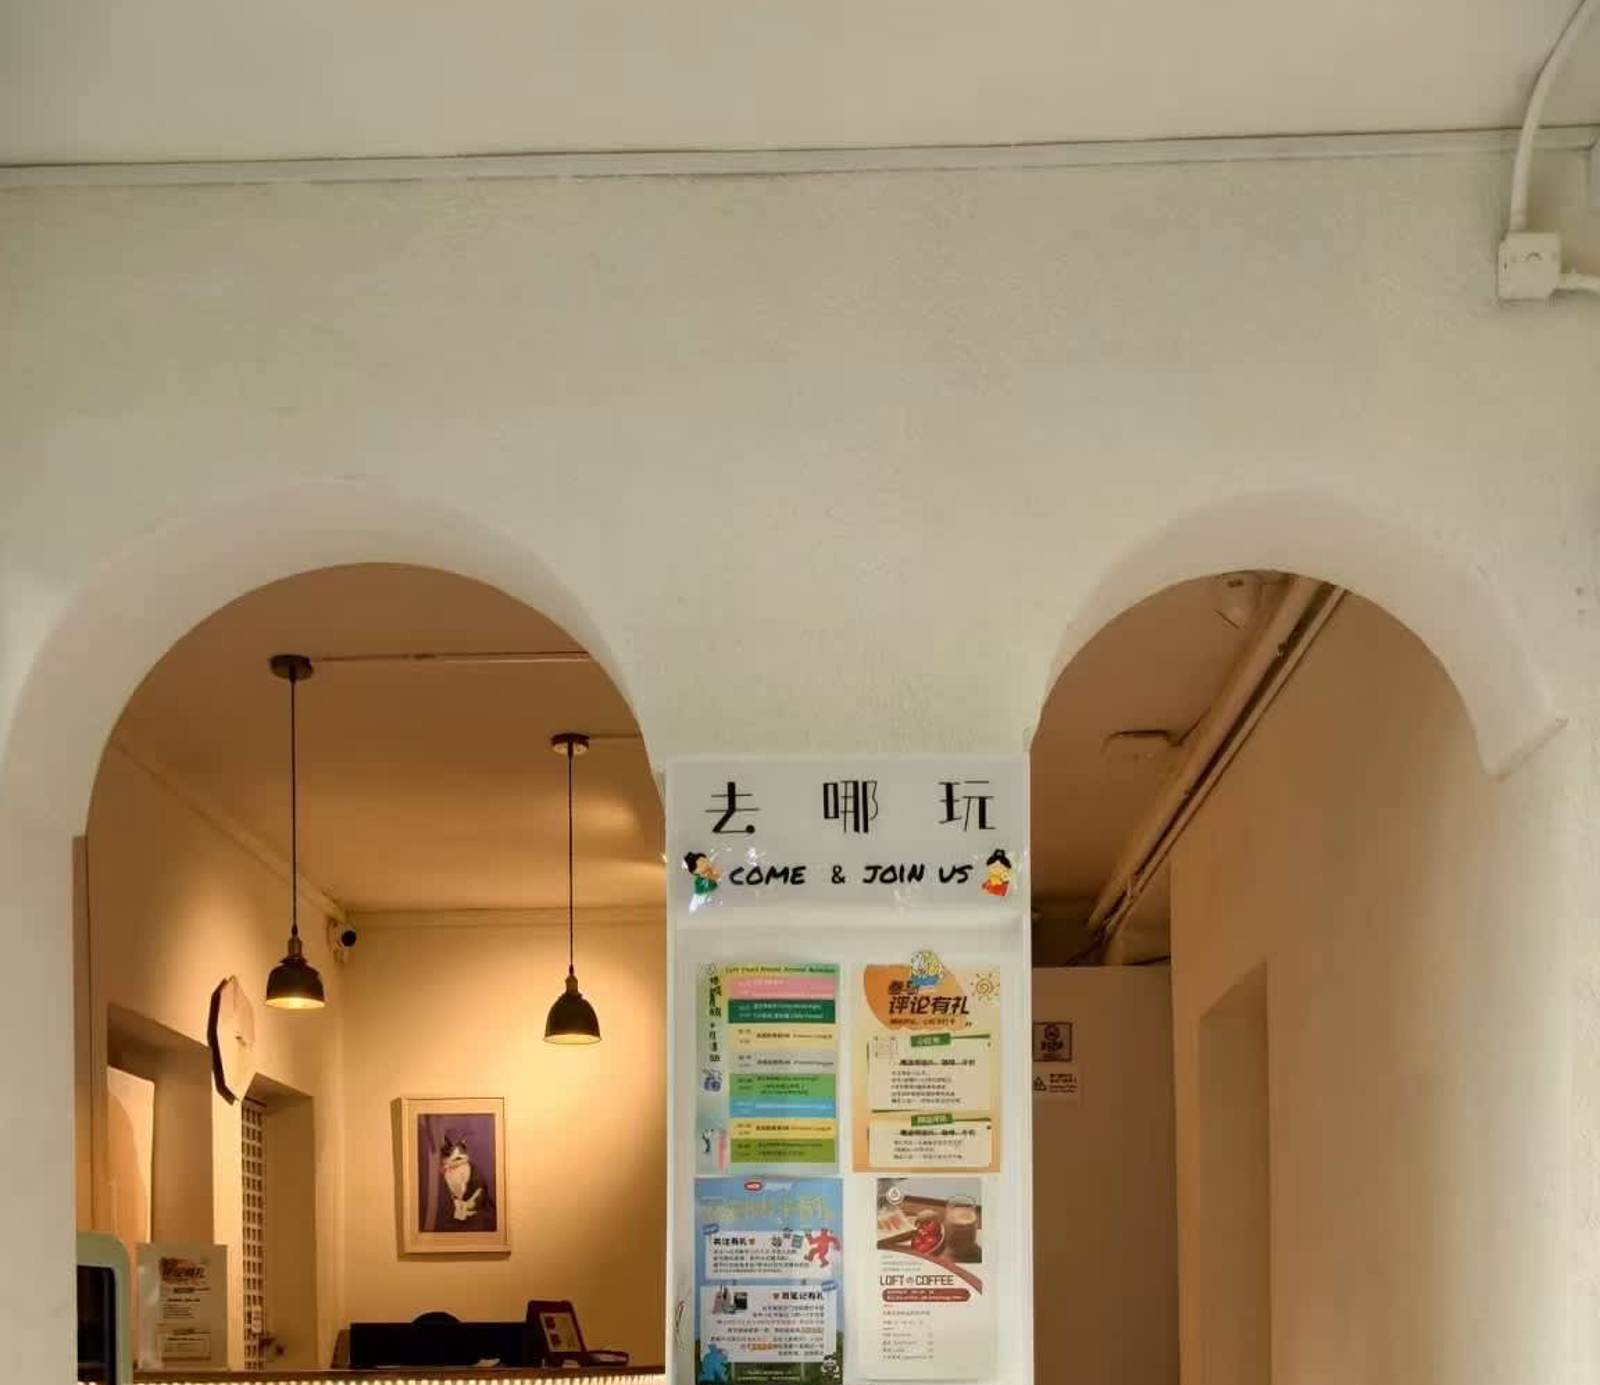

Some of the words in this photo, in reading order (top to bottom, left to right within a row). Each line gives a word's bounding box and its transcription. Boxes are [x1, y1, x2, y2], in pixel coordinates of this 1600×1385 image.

[705, 780, 996, 833] 去哪玩
[729, 865, 807, 885] COME
[831, 865, 846, 884] &
[862, 863, 925, 884] JOIN
[938, 865, 973, 883] US
[889, 996, 970, 1014] 评论有礼
